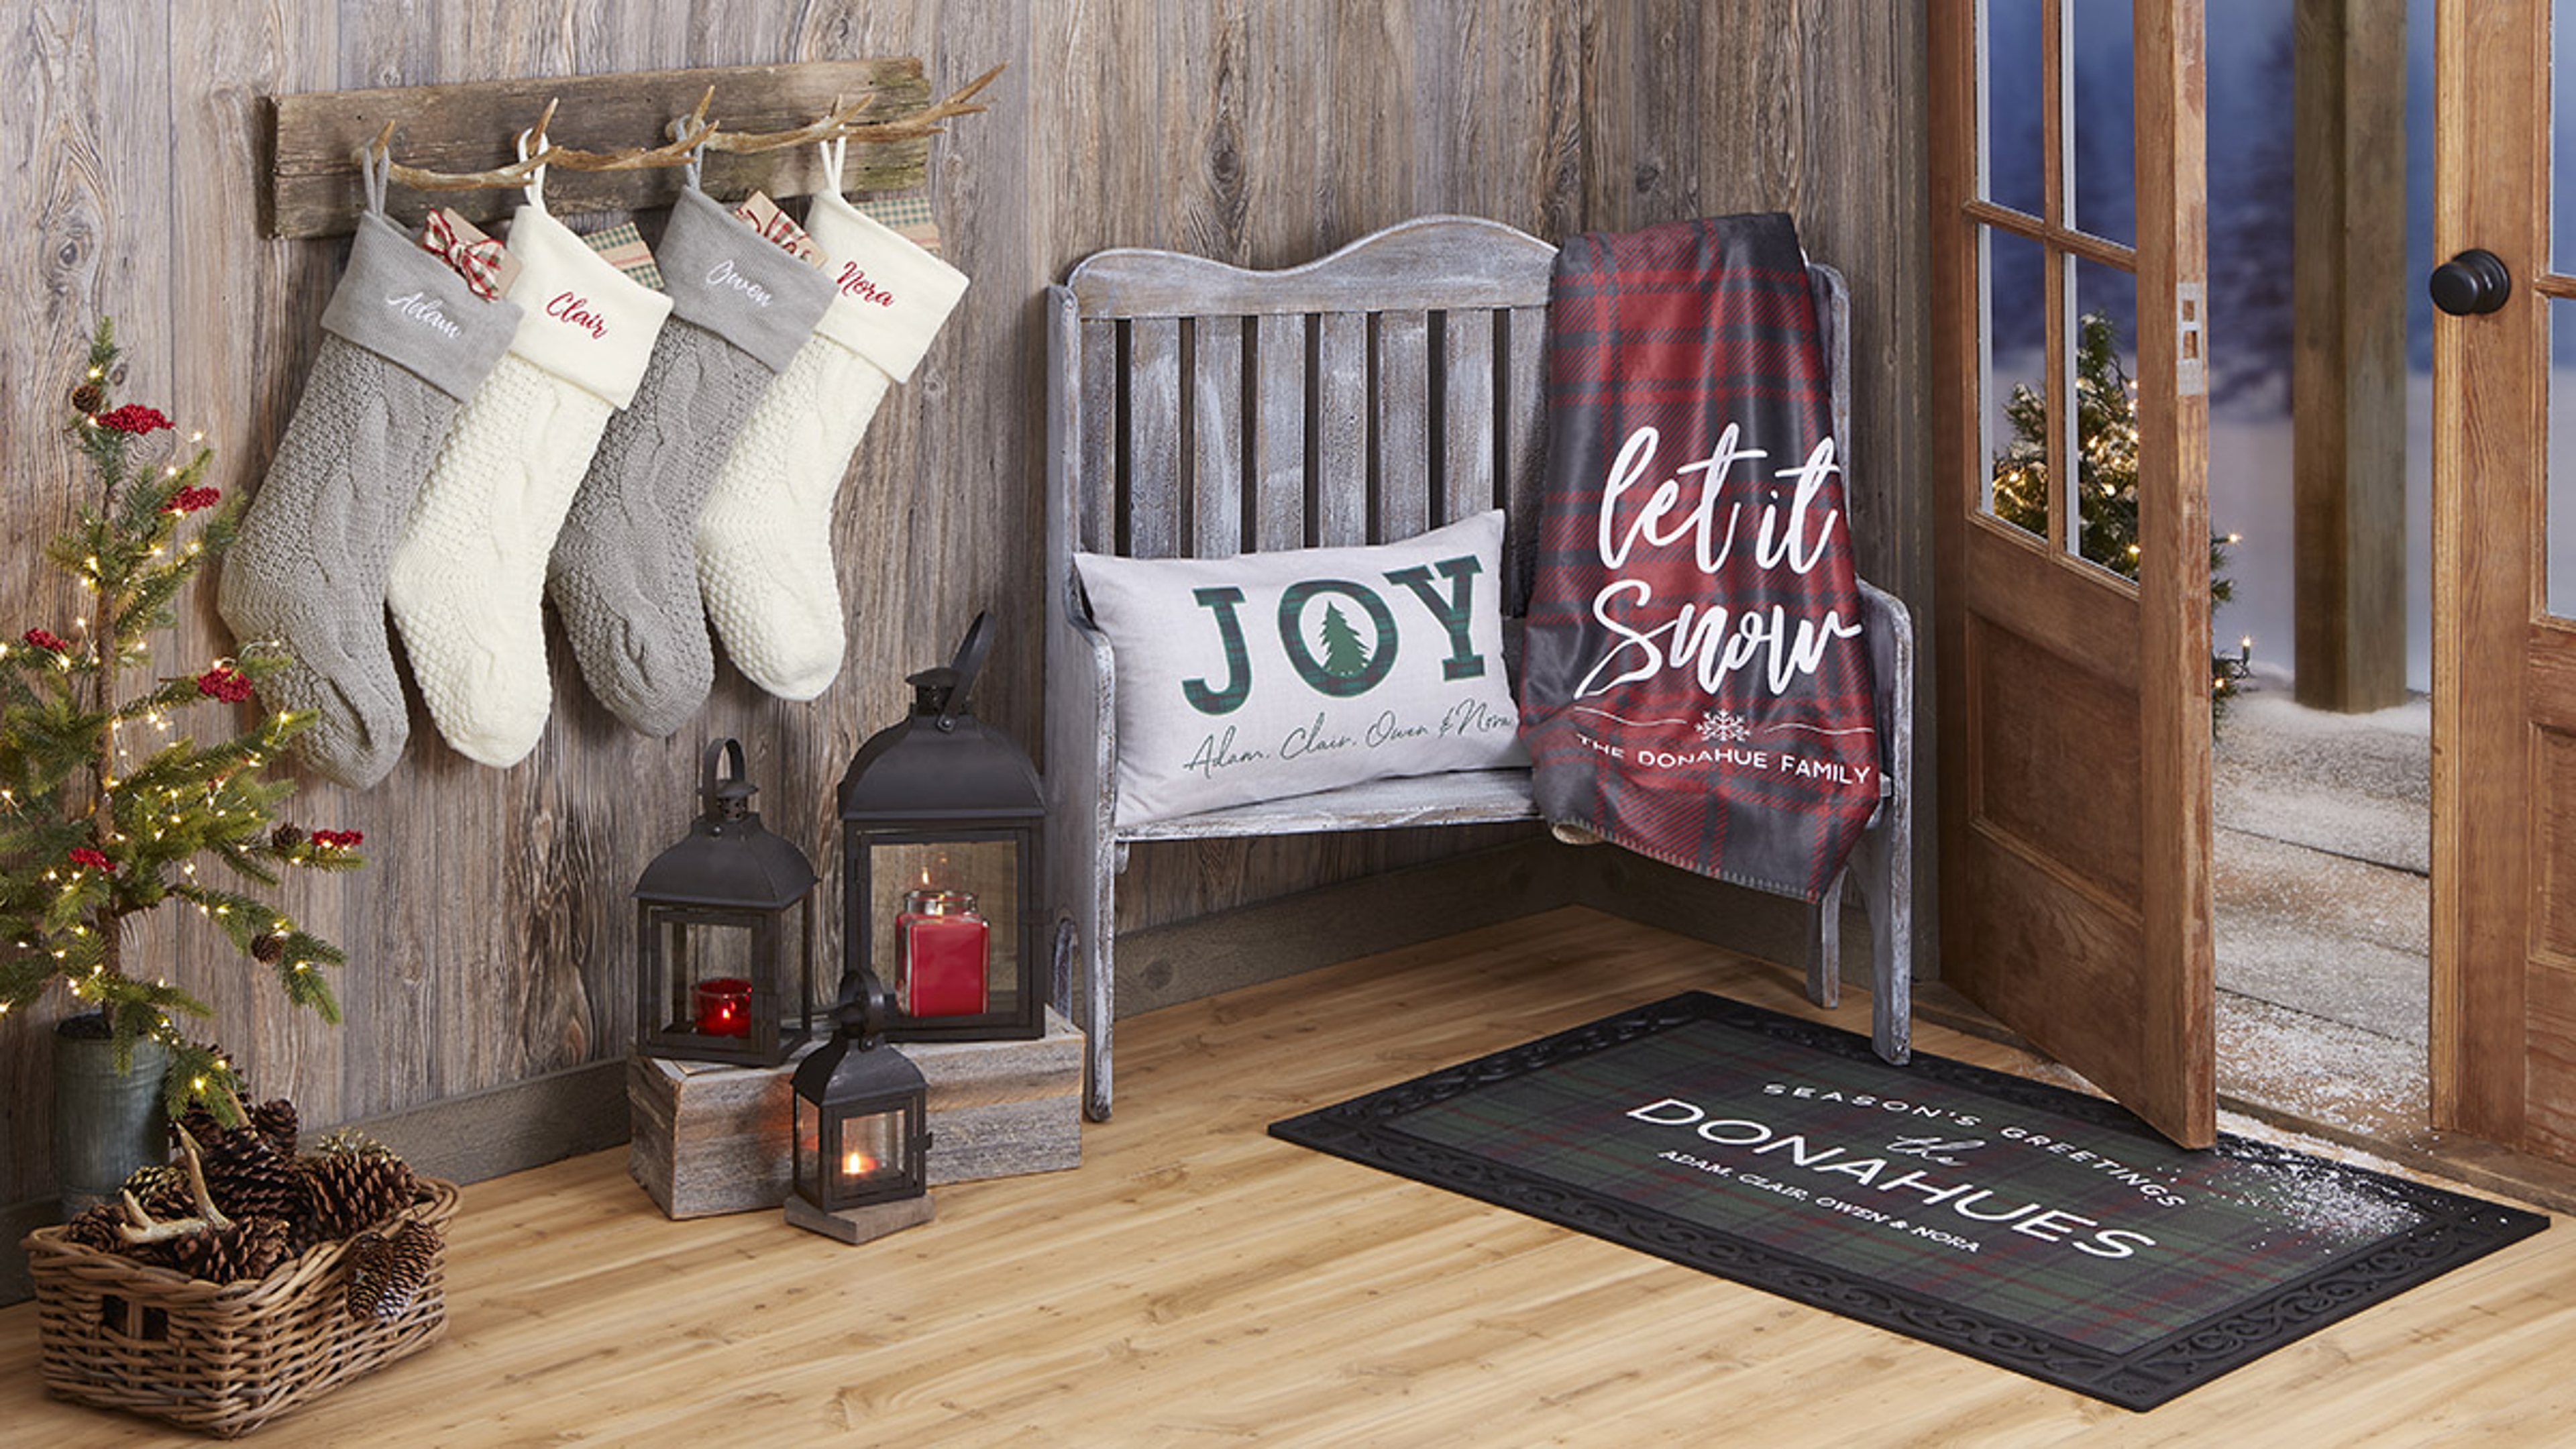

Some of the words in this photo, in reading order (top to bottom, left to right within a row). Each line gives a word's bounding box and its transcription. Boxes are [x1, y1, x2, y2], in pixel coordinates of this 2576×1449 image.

[706, 259, 773, 307] Owen
[837, 260, 894, 307] Nora
[386, 291, 462, 338] Adam
[545, 291, 608, 339] Clair
[1599, 423, 1768, 574] let
[1755, 436, 1841, 574] it
[1181, 554, 1487, 716] JOY
[1365, 710, 1429, 748] Owen
[1439, 707, 1454, 739] &
[1576, 733, 1626, 759] THE
[1637, 748, 1768, 769] DONAHUE
[1780, 755, 1871, 785] FAMILY
[1763, 1083, 1982, 1126] SEASON'S
[2000, 1126, 2186, 1208] GREETINGS
[1886, 1135, 1986, 1167] the
[1626, 1097, 2157, 1259] DONAHUES
[1815, 1197, 1892, 1224] OWEN
[1888, 1219, 1909, 1230] &
[1911, 1225, 1981, 1254] NORA
